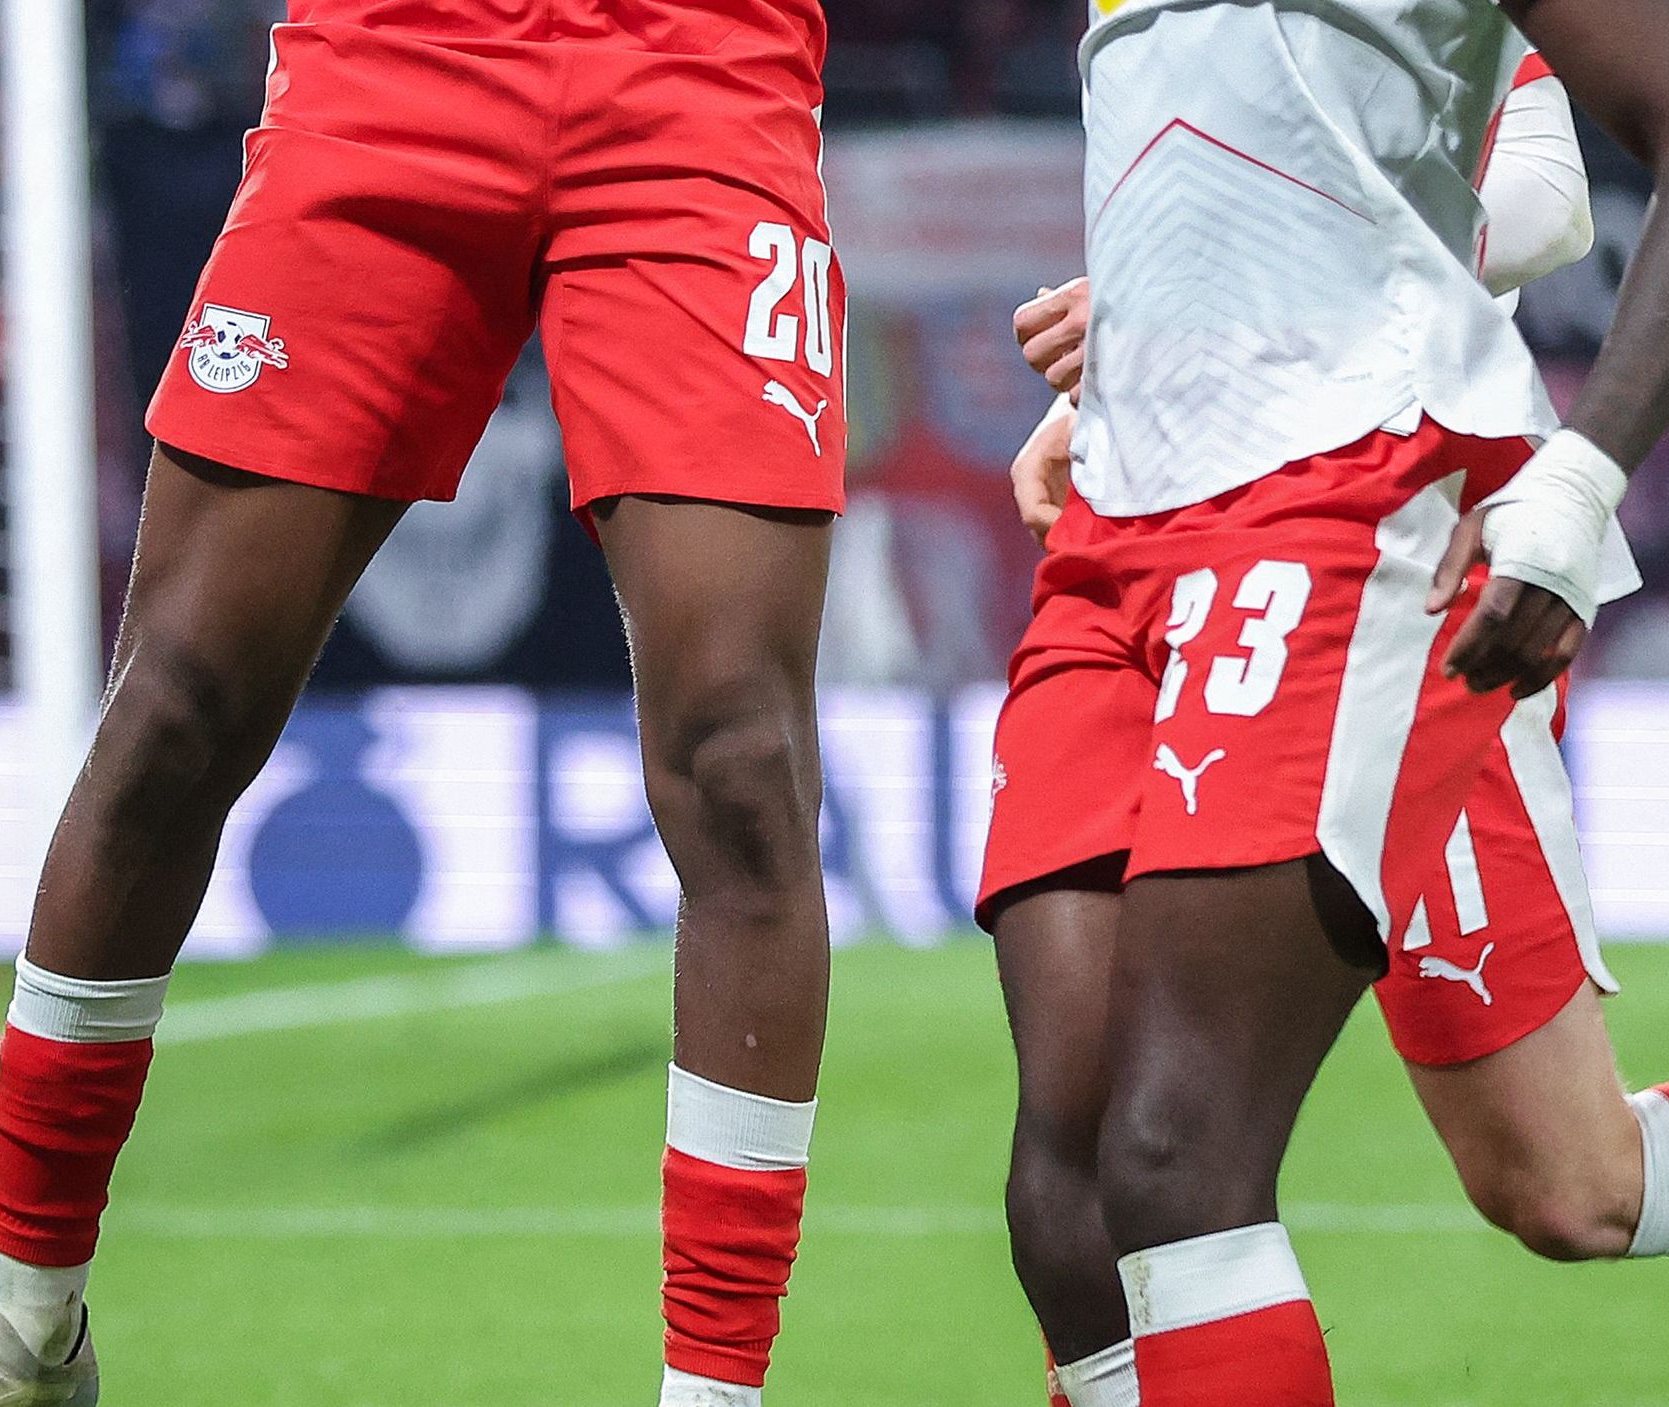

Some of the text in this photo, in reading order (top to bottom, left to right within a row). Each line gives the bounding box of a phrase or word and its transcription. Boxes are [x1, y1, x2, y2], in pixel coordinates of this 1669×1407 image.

[207, 359, 252, 382] LEIPZIG
[742, 220, 834, 379] 20
[1153, 558, 1313, 726] 23
